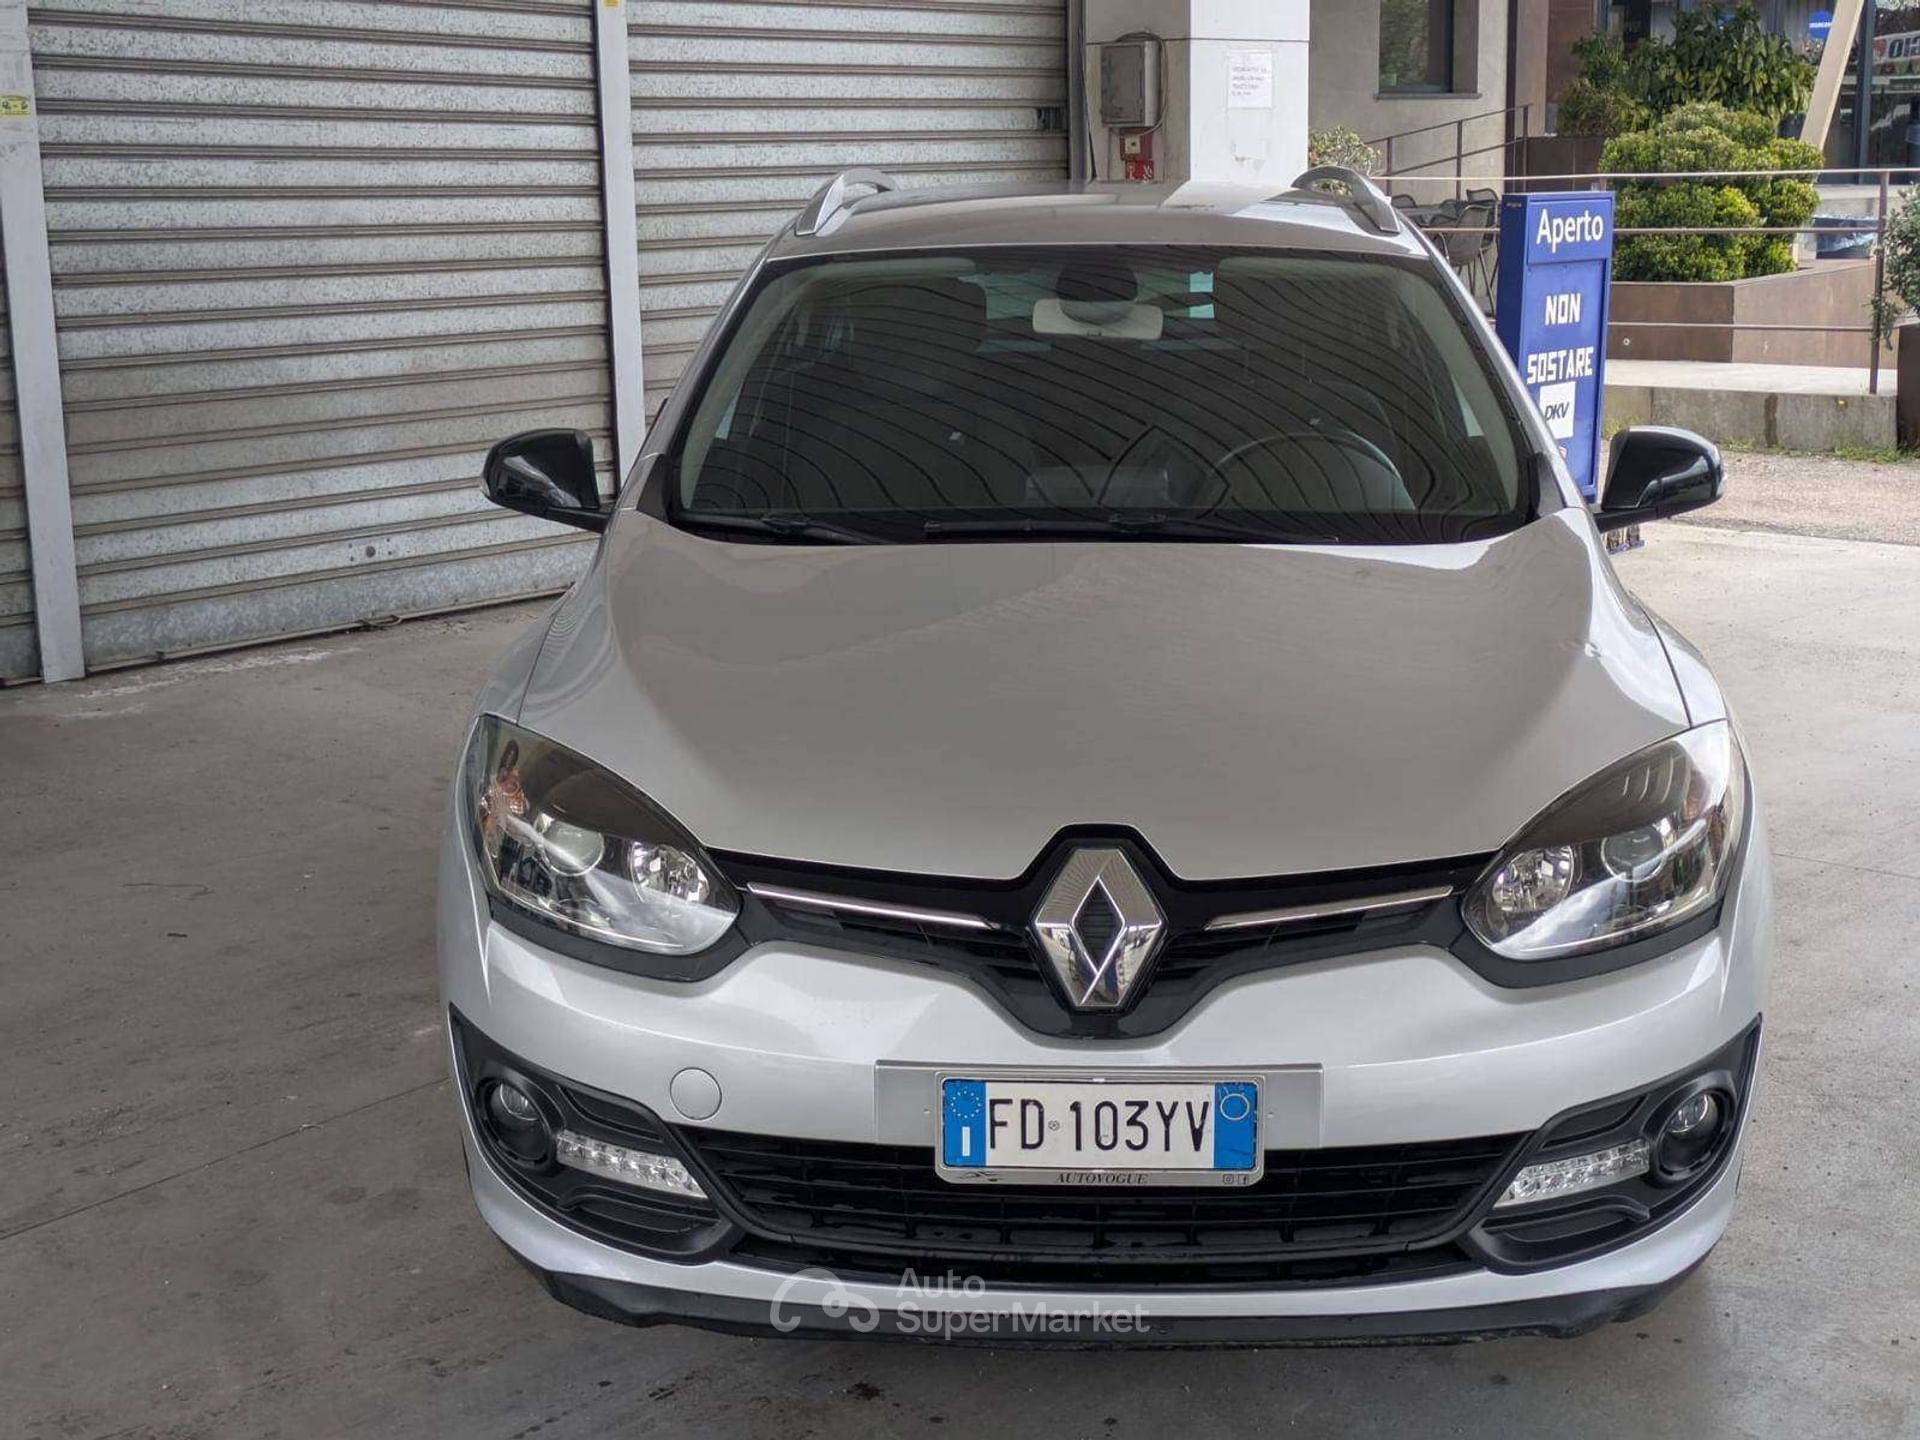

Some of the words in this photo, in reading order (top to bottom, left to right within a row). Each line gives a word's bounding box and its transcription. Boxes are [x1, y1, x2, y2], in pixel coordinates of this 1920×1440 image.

[1536, 208, 1604, 253] Aperto
[1545, 293, 1581, 326] NON
[1527, 347, 1594, 385] SOSTARE
[1545, 401, 1570, 421] DKV
[988, 1099, 1045, 1150] FD
[1069, 1100, 1210, 1152] 103YV
[1055, 1173, 1149, 1185] AUTOVOGUE
